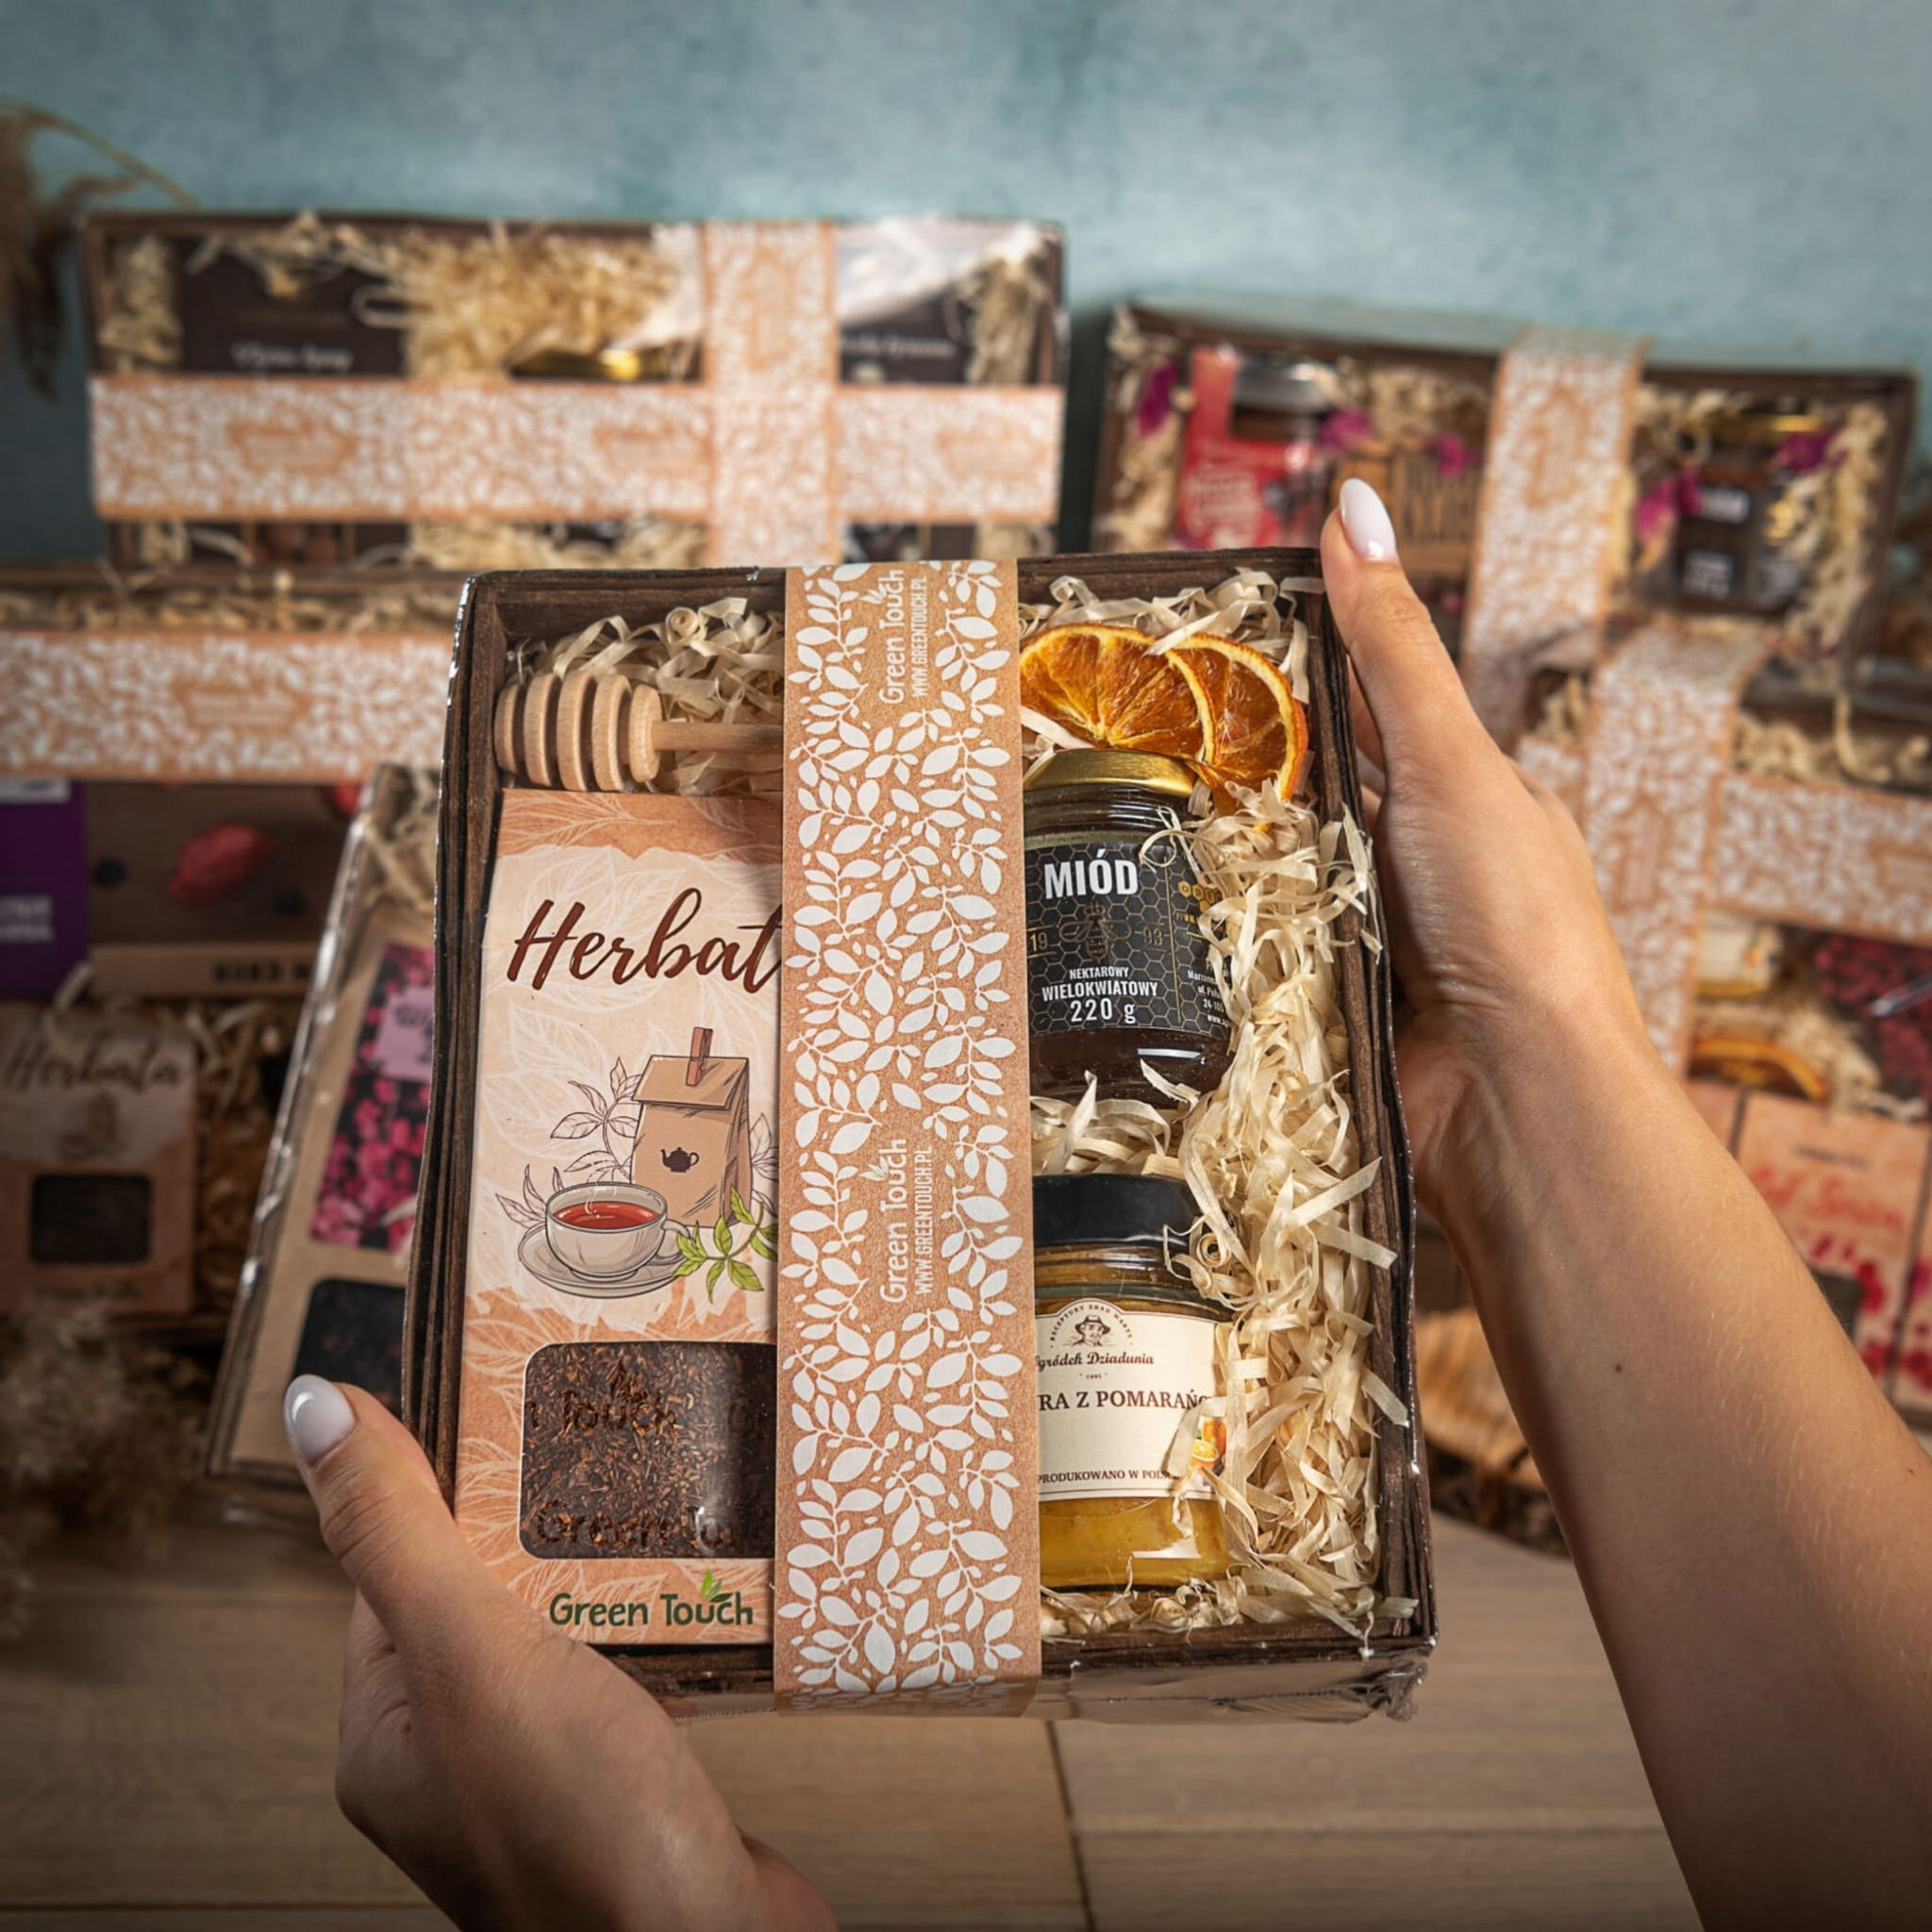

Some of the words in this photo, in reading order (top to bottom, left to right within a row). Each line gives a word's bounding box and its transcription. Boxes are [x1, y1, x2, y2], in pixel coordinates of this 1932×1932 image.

[877, 570, 906, 628] Touch
[910, 575, 928, 697] WWW.GREENTOUCH.PL
[878, 637, 906, 704] Green
[1044, 849, 1138, 899] MIÓD
[507, 887, 782, 993] Herbat
[1041, 980, 1158, 1002] WIELOKWIATOWY
[1069, 966, 1129, 980] NEKTAROWY
[1070, 996, 1113, 1023] 220
[1124, 1003, 1137, 1024] g
[877, 1139, 908, 1212] Touch
[914, 1145, 933, 1295] WWW.GREENTOUCH.PL
[878, 1222, 908, 1304] Green
[1087, 1352, 1155, 1365] Dziadunia
[1039, 1393, 1070, 1411] RA
[1076, 1391, 1090, 1408] Z
[1128, 1470, 1139, 1479] W
[549, 1592, 649, 1626] Green
[659, 1591, 754, 1626] Touch
